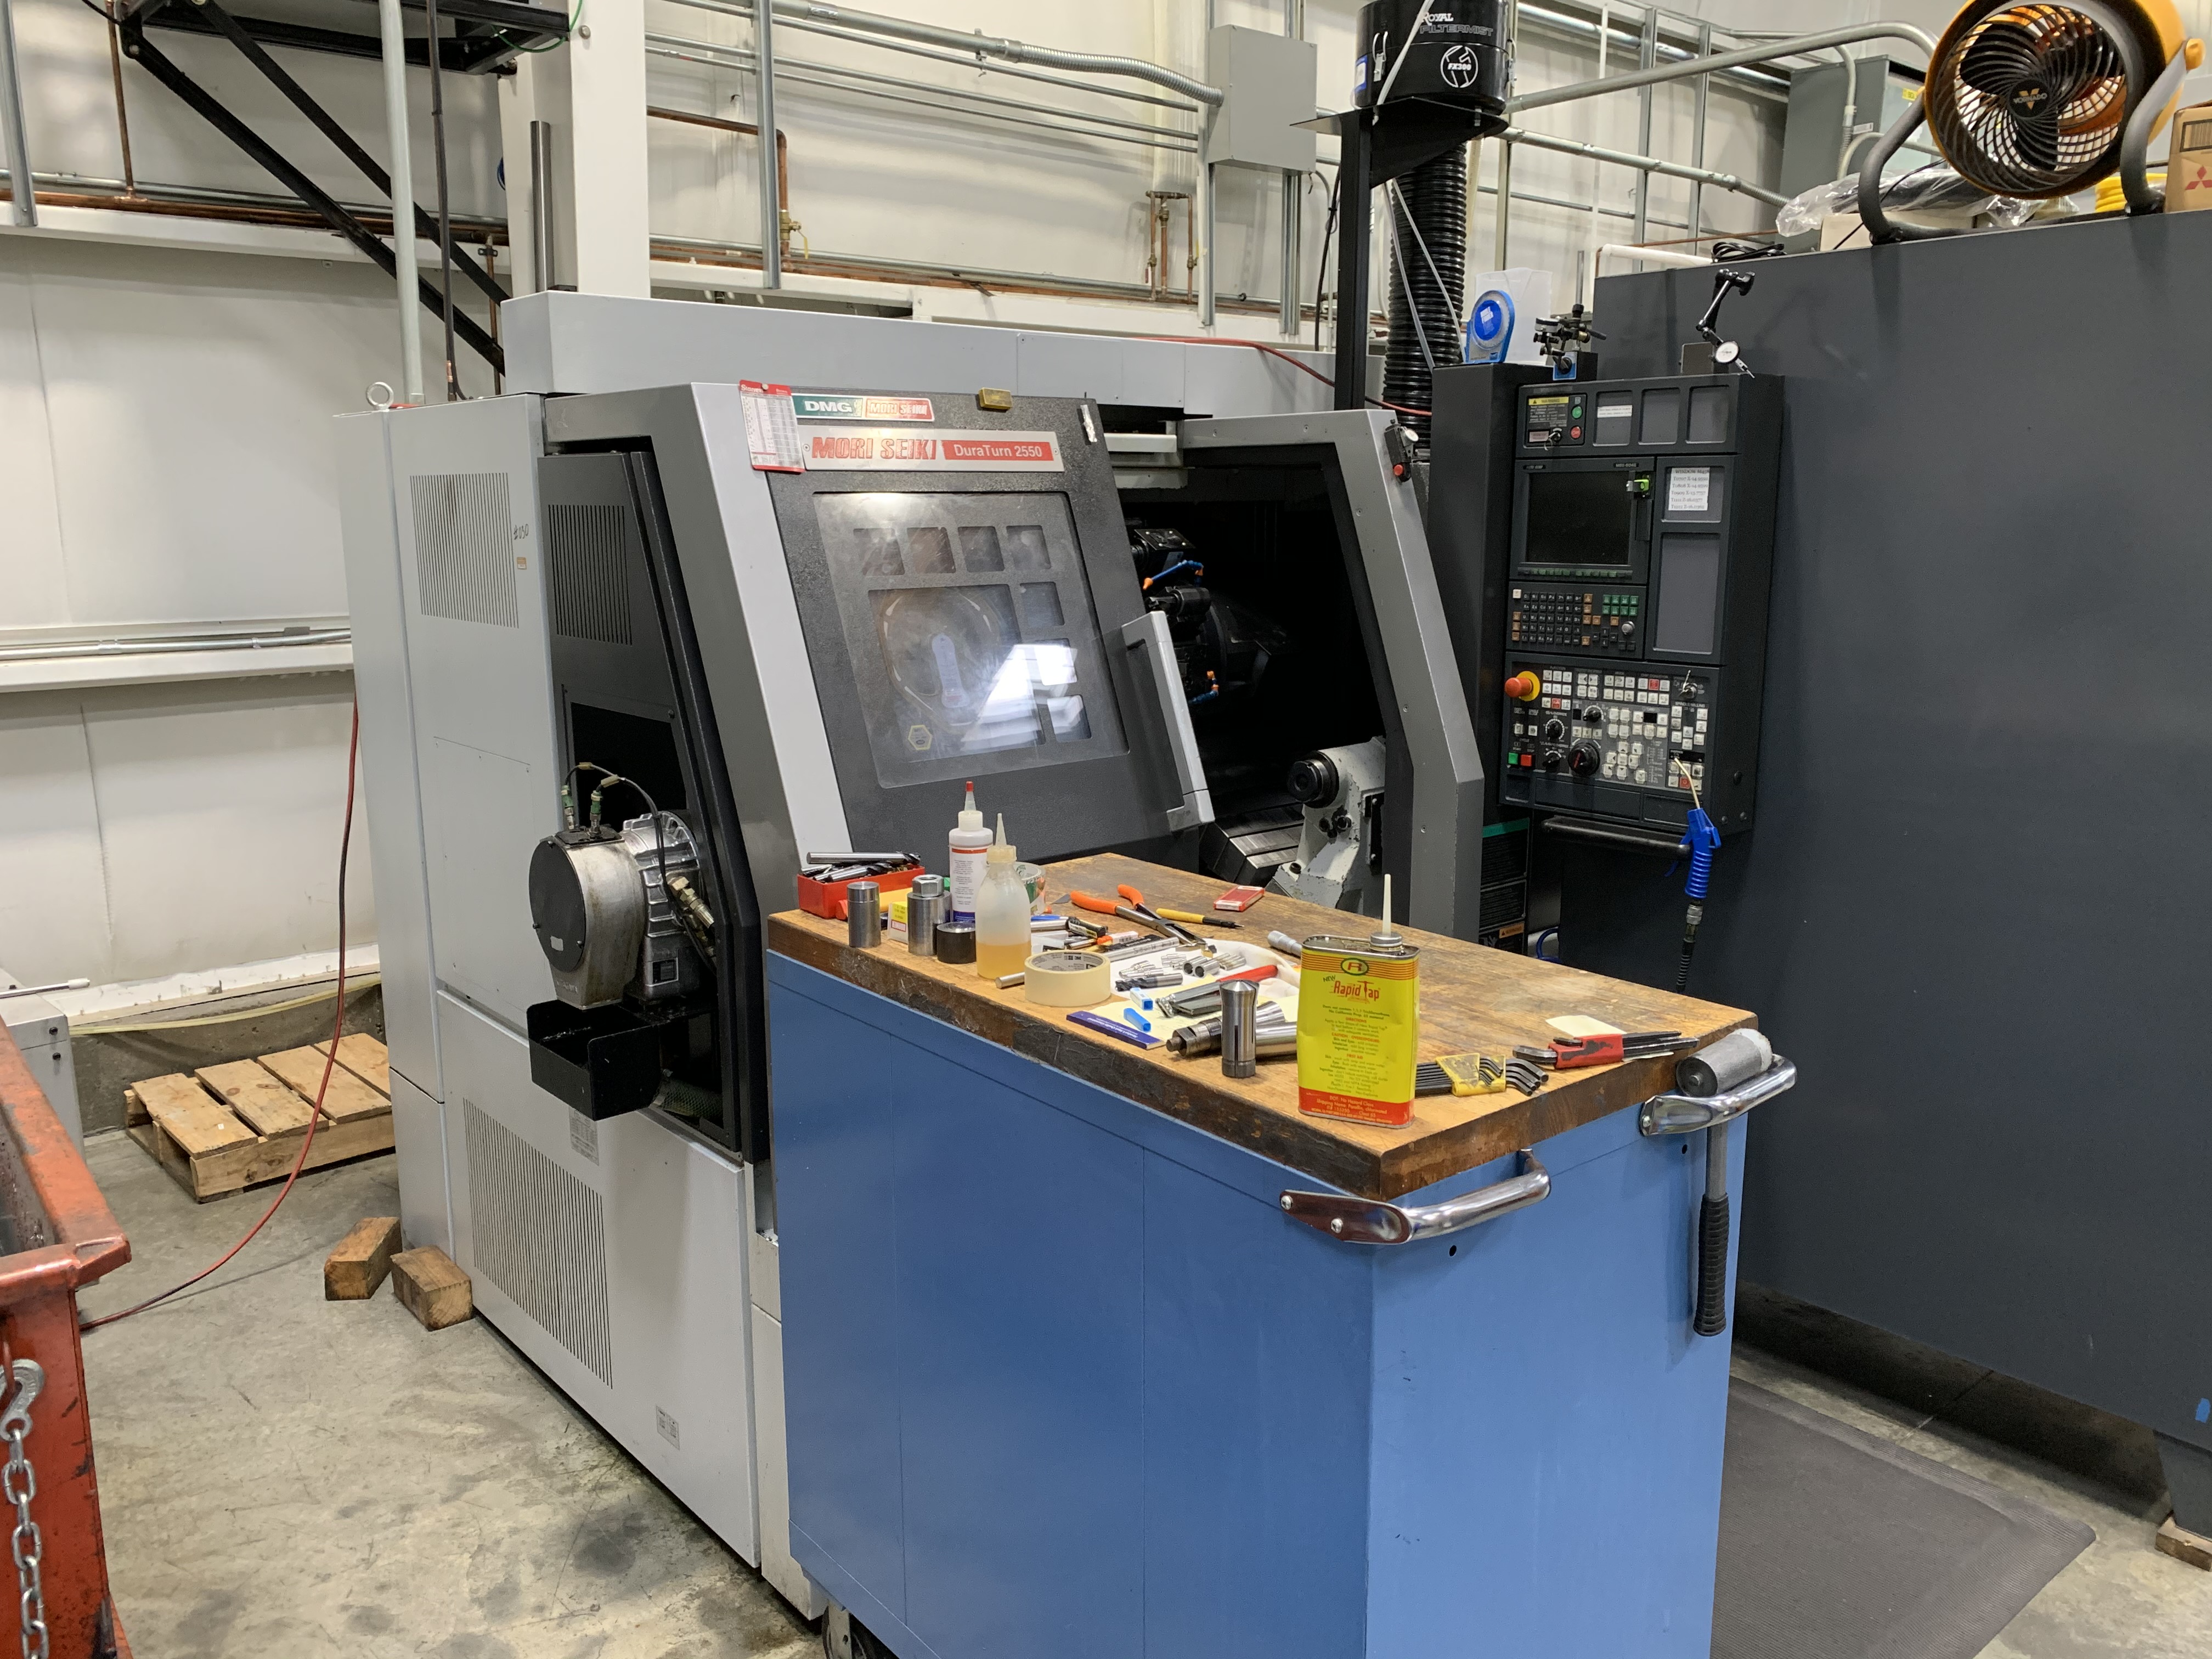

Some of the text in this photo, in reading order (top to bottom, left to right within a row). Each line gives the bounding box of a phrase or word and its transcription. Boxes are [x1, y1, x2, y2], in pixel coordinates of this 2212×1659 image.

[1421, 12, 1453, 26] ROYAL
[1420, 24, 1493, 37] FILTERMIST
[1447, 63, 1472, 71] FX300
[2013, 93, 2047, 104] VORNADO
[804, 400, 928, 415] DMG MORI SEIKI
[811, 437, 937, 460] MORI SEIKI
[953, 444, 1042, 458] DuraTurn 2550
[1347, 962, 1362, 972] R
[1334, 980, 1362, 997] Rapid
